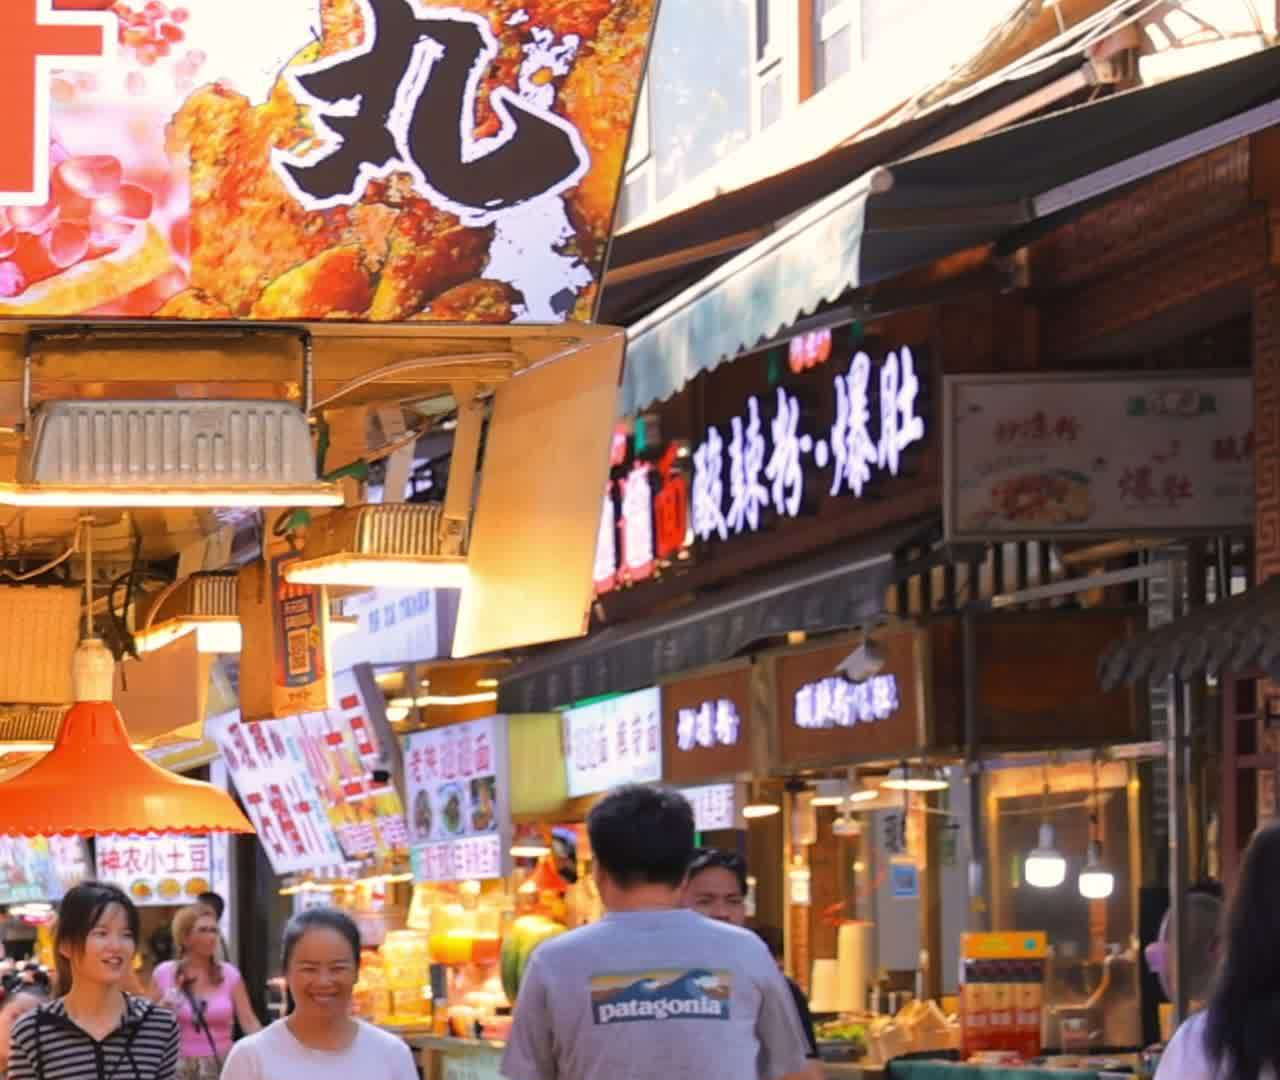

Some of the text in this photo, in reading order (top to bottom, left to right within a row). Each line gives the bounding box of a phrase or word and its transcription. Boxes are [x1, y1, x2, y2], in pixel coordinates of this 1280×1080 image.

[99, 843, 210, 877] 神农小土豆
[598, 995, 723, 1023] patagonia
